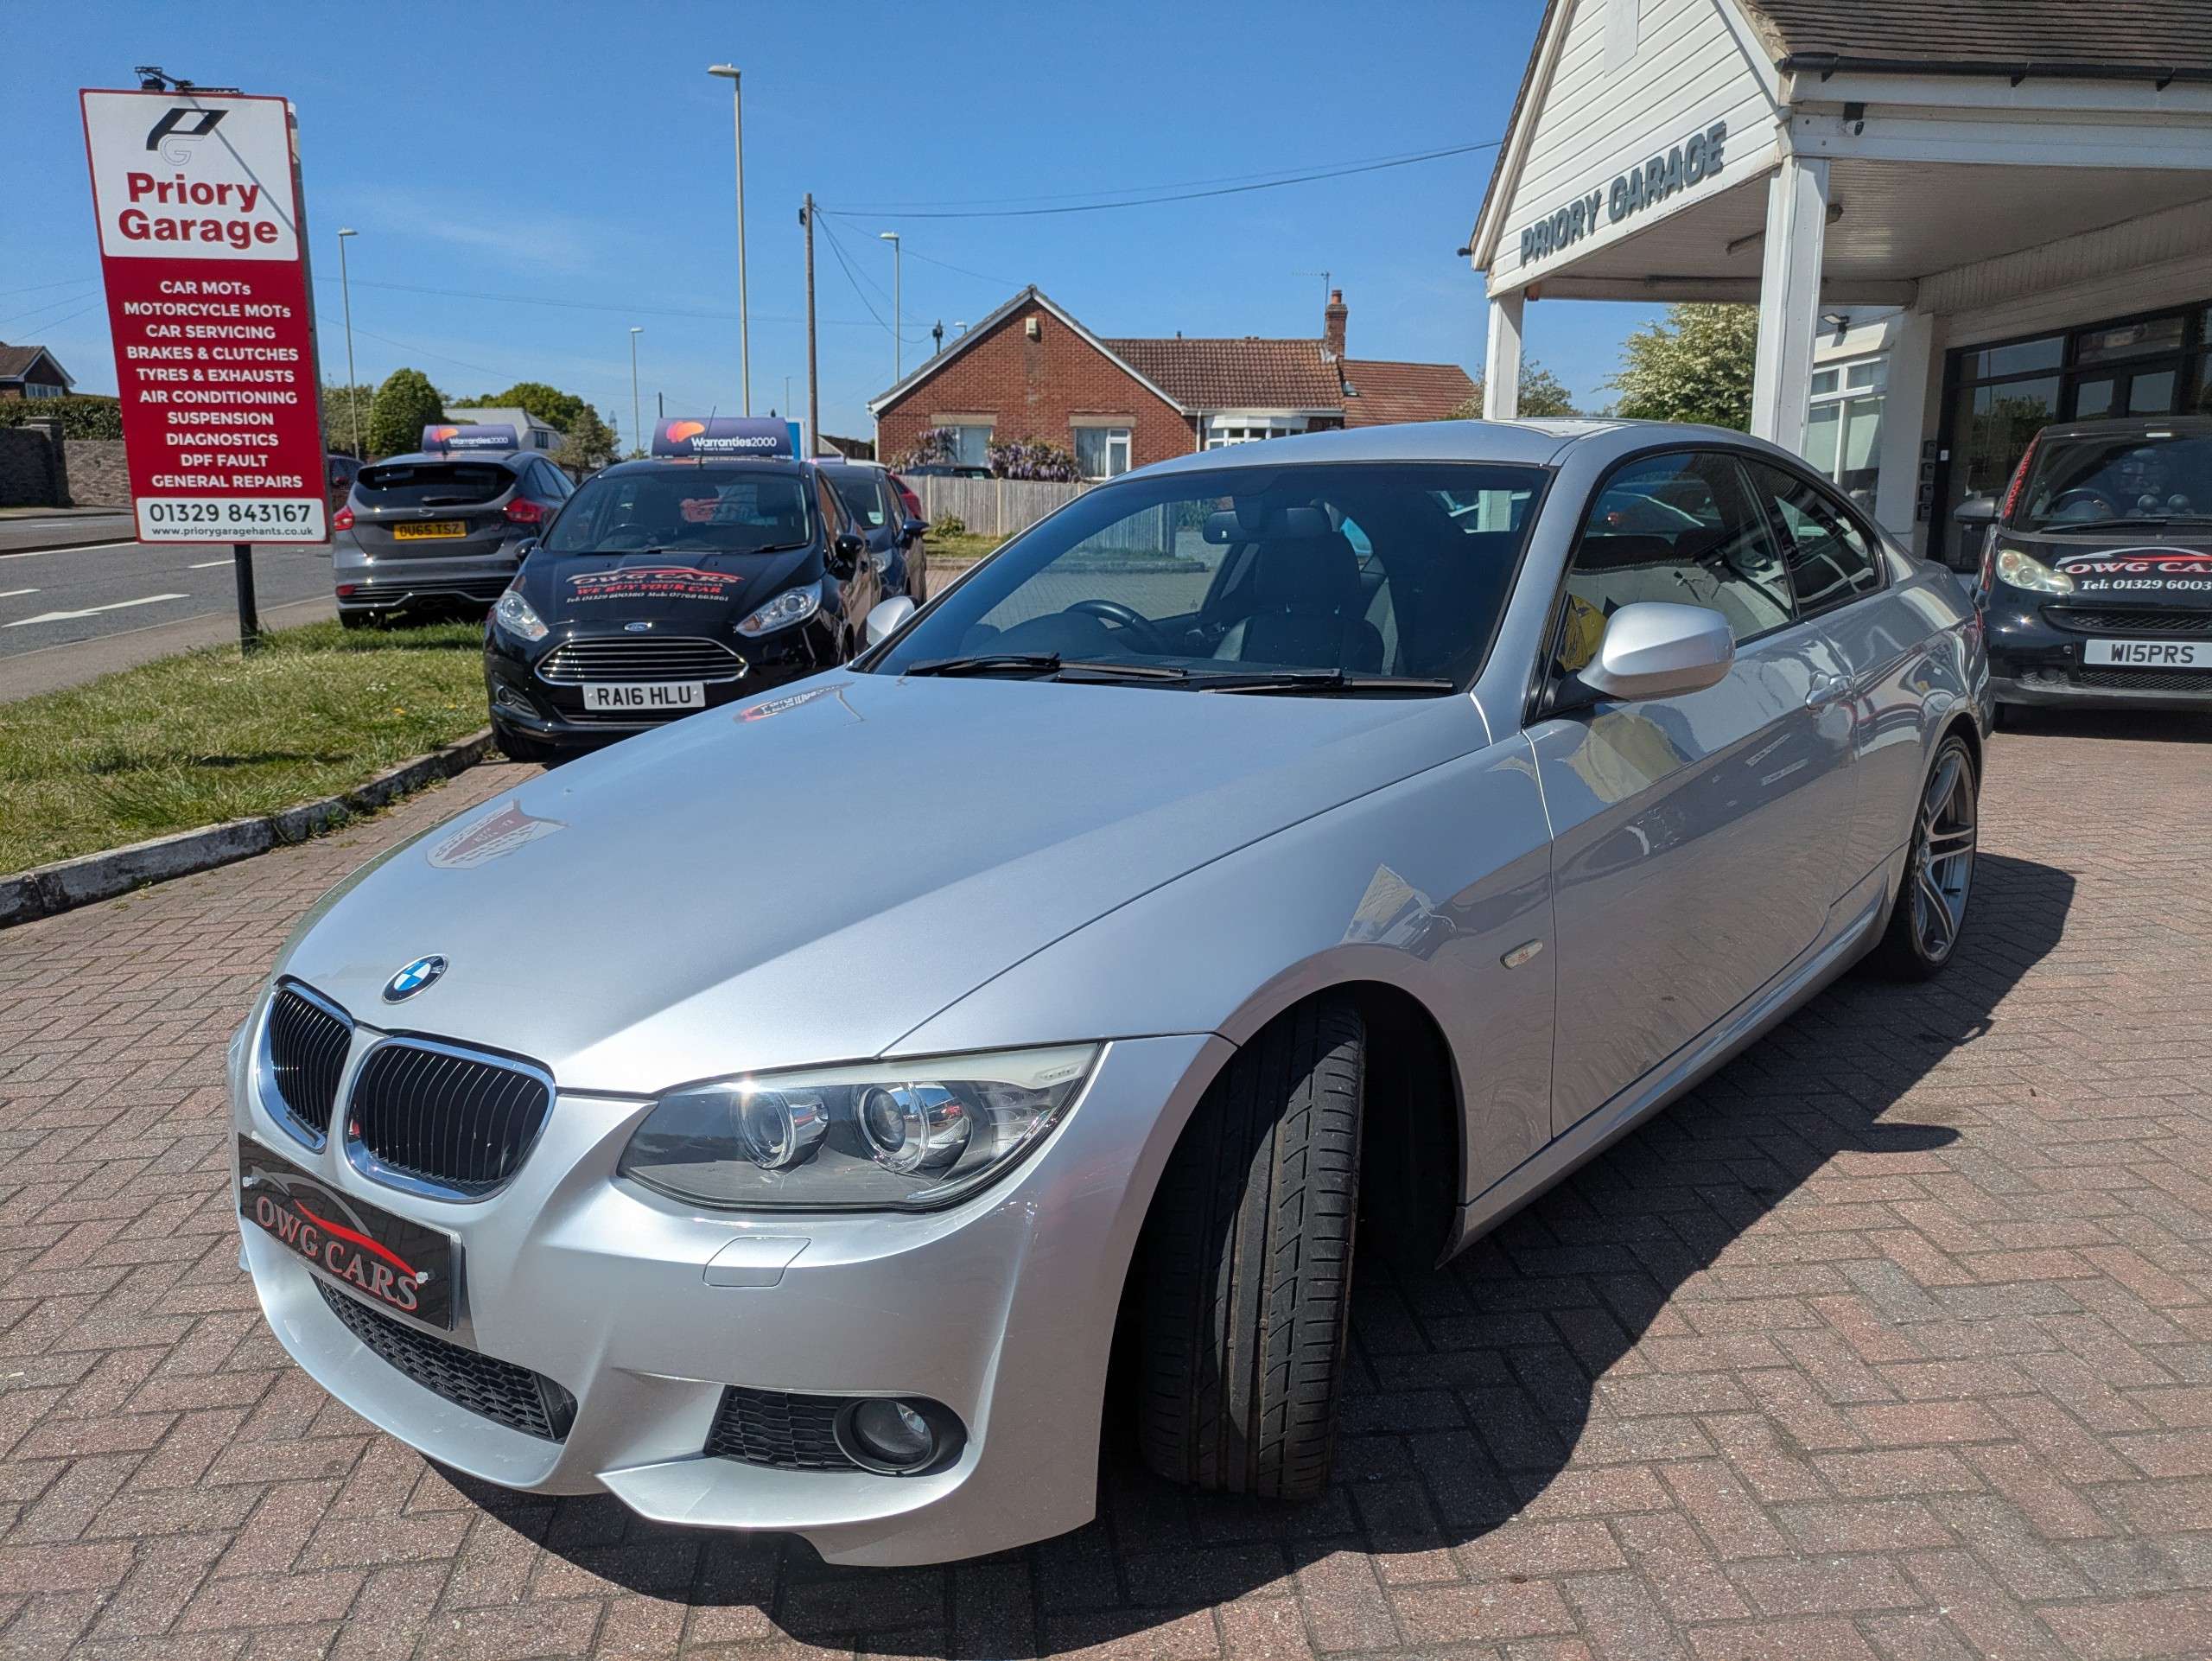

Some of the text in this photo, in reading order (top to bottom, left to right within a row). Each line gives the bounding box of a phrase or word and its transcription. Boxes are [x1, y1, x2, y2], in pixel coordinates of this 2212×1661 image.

[126, 172, 259, 213] Priory
[1520, 119, 1727, 269] PRIORY GARAGE
[118, 209, 278, 250] Garage
[160, 281, 251, 295] CAR MOTs
[124, 302, 291, 317] MOTORCYCLE MOTs
[146, 325, 276, 339] CAR SERVICING
[127, 346, 299, 361] BRAKES & CLUTCHES
[136, 367, 295, 382] TYRES & EXHAUSTS
[139, 390, 297, 404] AIR CONDITIONING
[167, 412, 274, 425] SUSPENSION
[166, 433, 279, 447] DIAGNOSTICS
[691, 436, 777, 448] Warranties2000
[180, 454, 268, 468] DPF FAULT
[151, 474, 303, 488] GENERAL REPAIRS
[149, 503, 311, 523] 01329 843167
[151, 526, 314, 538] www.priorygaragehants.co.uk
[2064, 562, 2212, 574] OWG CA
[573, 572, 648, 585] OWG
[655, 571, 738, 583] CARS
[2082, 580, 2109, 590] Tel:
[2113, 580, 2162, 590] 01329
[576, 585, 604, 595] WE
[605, 583, 637, 593] BUY
[642, 583, 685, 592] YOUR
[688, 586, 723, 595] CAR
[598, 685, 691, 706] RA16 HLU
[257, 1196, 418, 1311] OWG CARS
